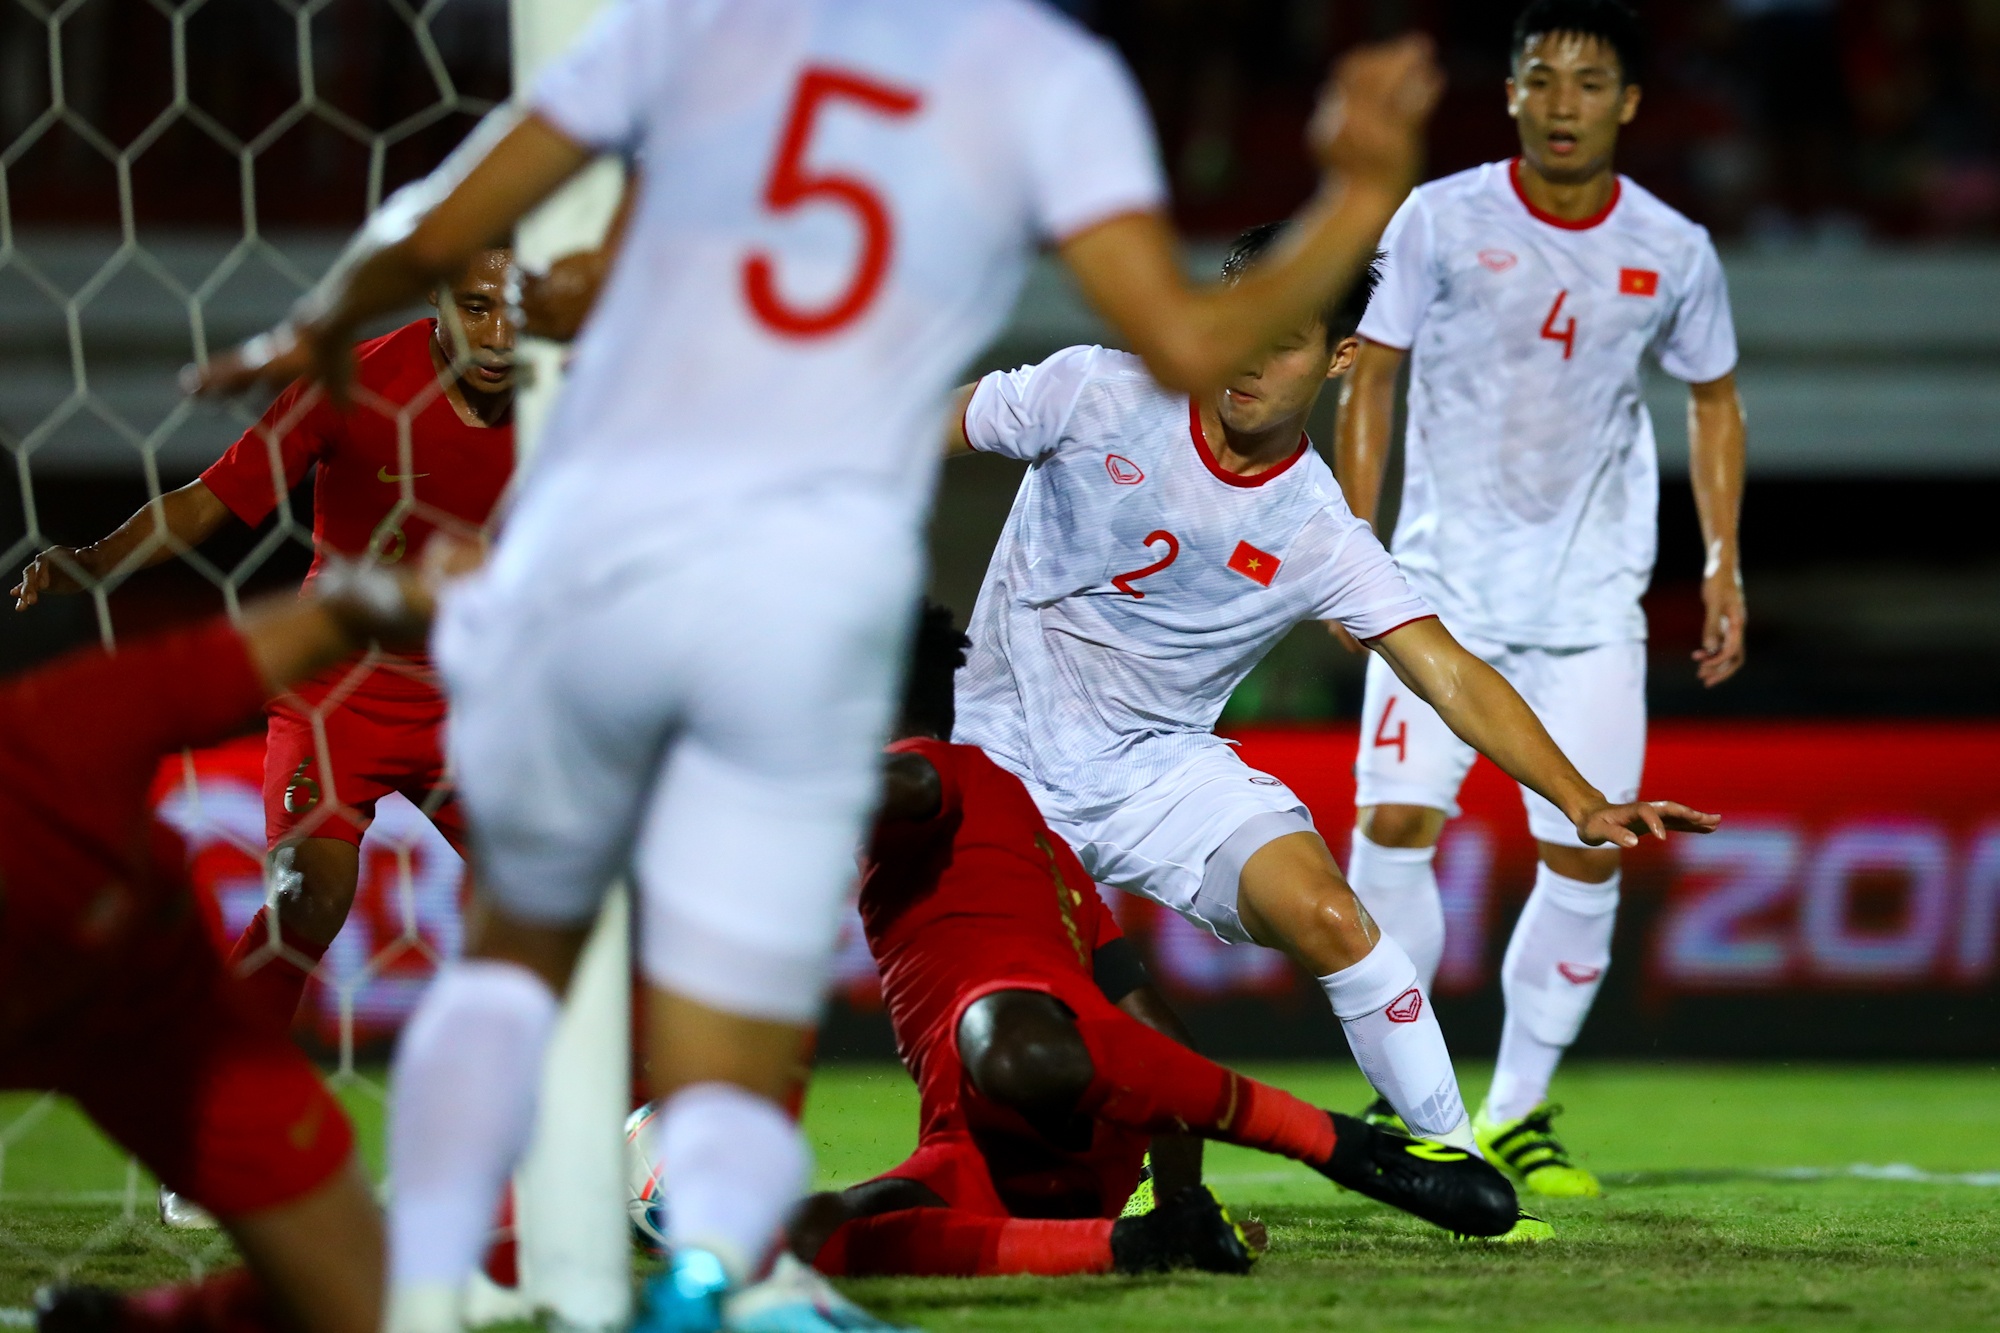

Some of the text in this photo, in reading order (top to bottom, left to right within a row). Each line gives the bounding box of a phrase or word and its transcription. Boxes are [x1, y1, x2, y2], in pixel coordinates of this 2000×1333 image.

[741, 65, 922, 340] 5
[1540, 289, 1576, 360] 4
[1111, 530, 1179, 599] 2
[1373, 695, 1407, 762] 4
[284, 756, 319, 813] 6
